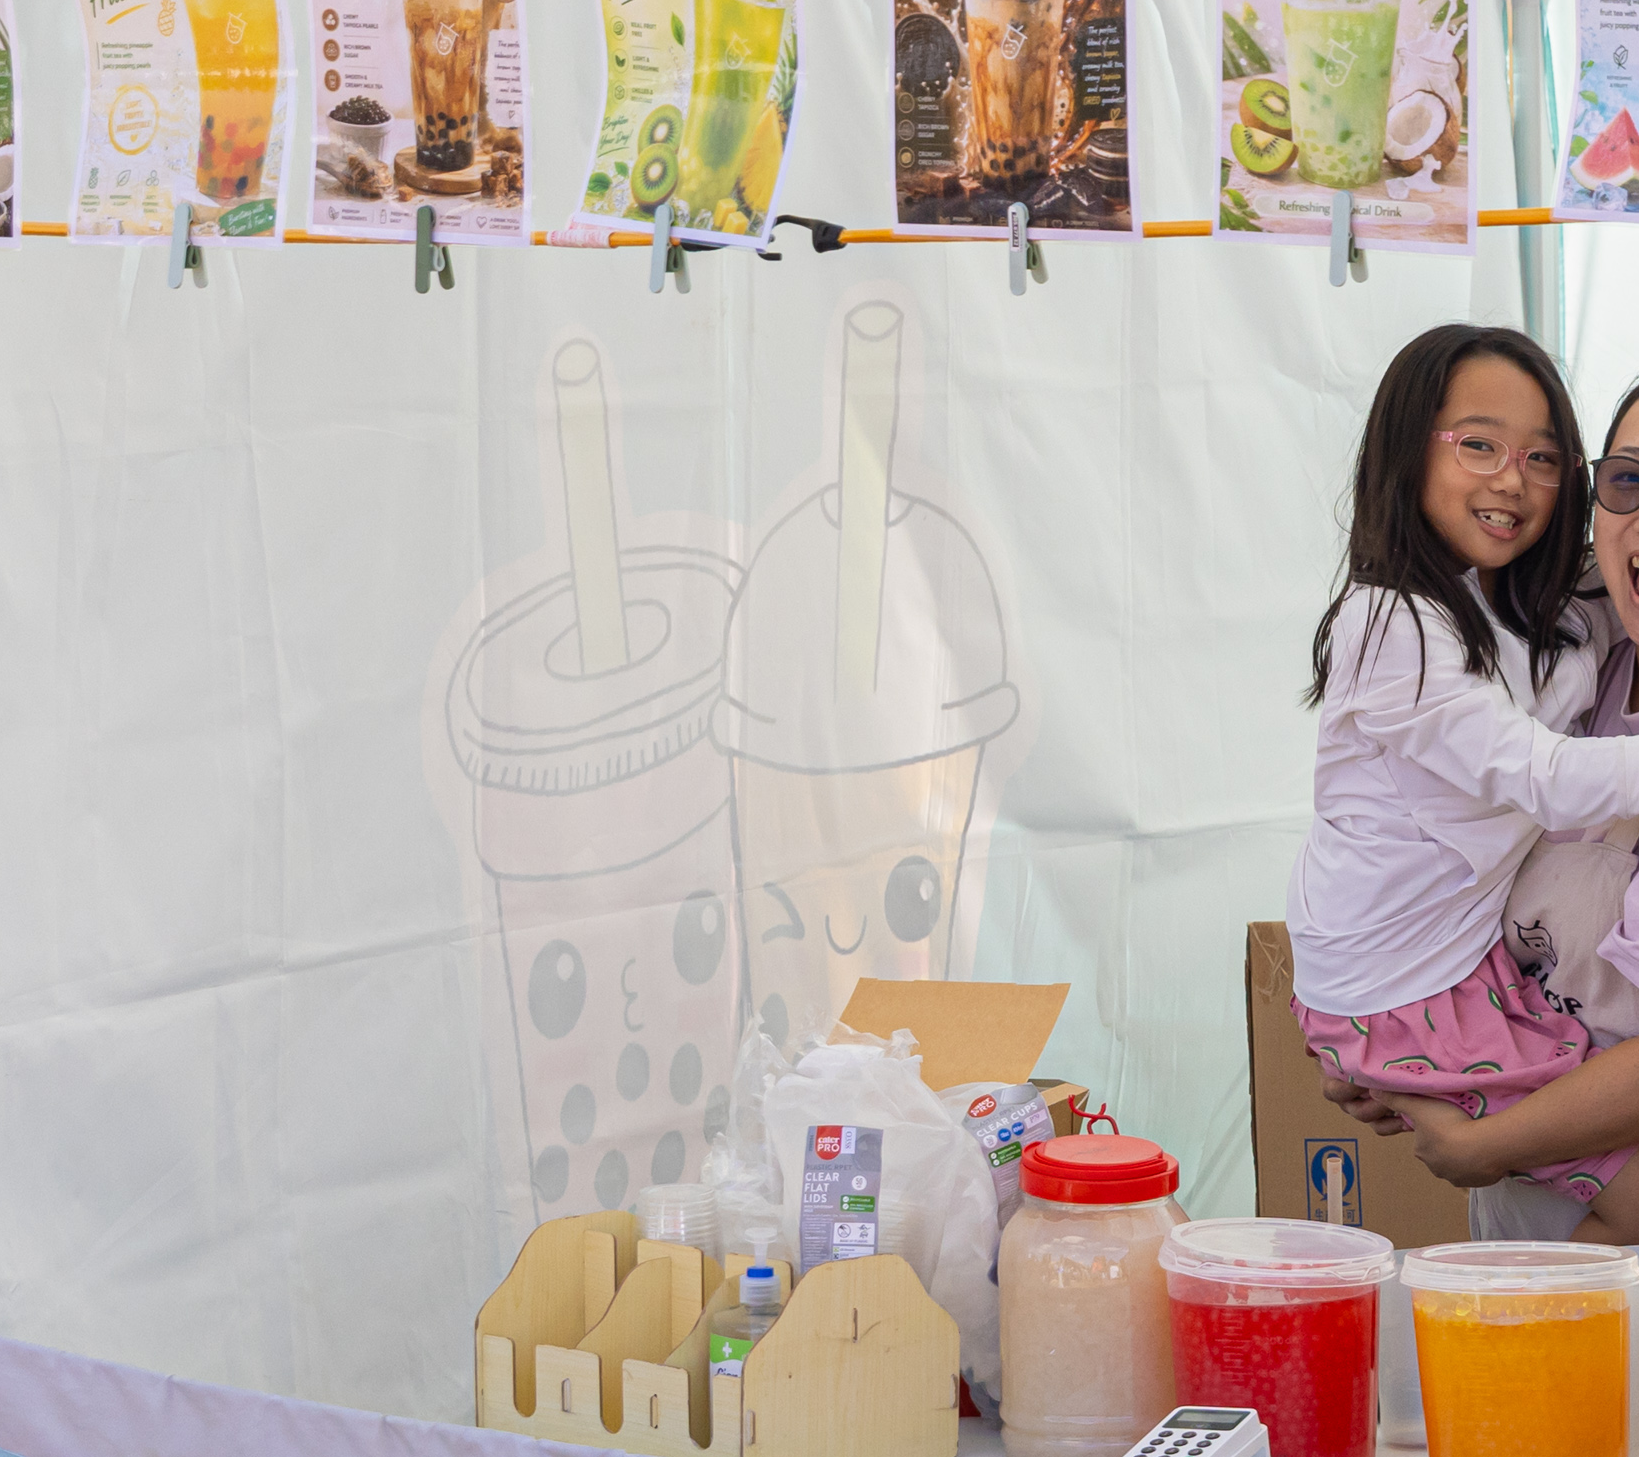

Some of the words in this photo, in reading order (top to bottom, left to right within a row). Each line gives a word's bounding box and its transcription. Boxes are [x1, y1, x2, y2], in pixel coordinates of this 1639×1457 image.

[1279, 201, 1330, 216] Refreshing
[1351, 204, 1371, 216] pical
[1374, 206, 1402, 217] Drink
[805, 1173, 839, 1181] CLEAR
[805, 1183, 830, 1192] FLAT
[804, 1194, 827, 1203] LIDS
